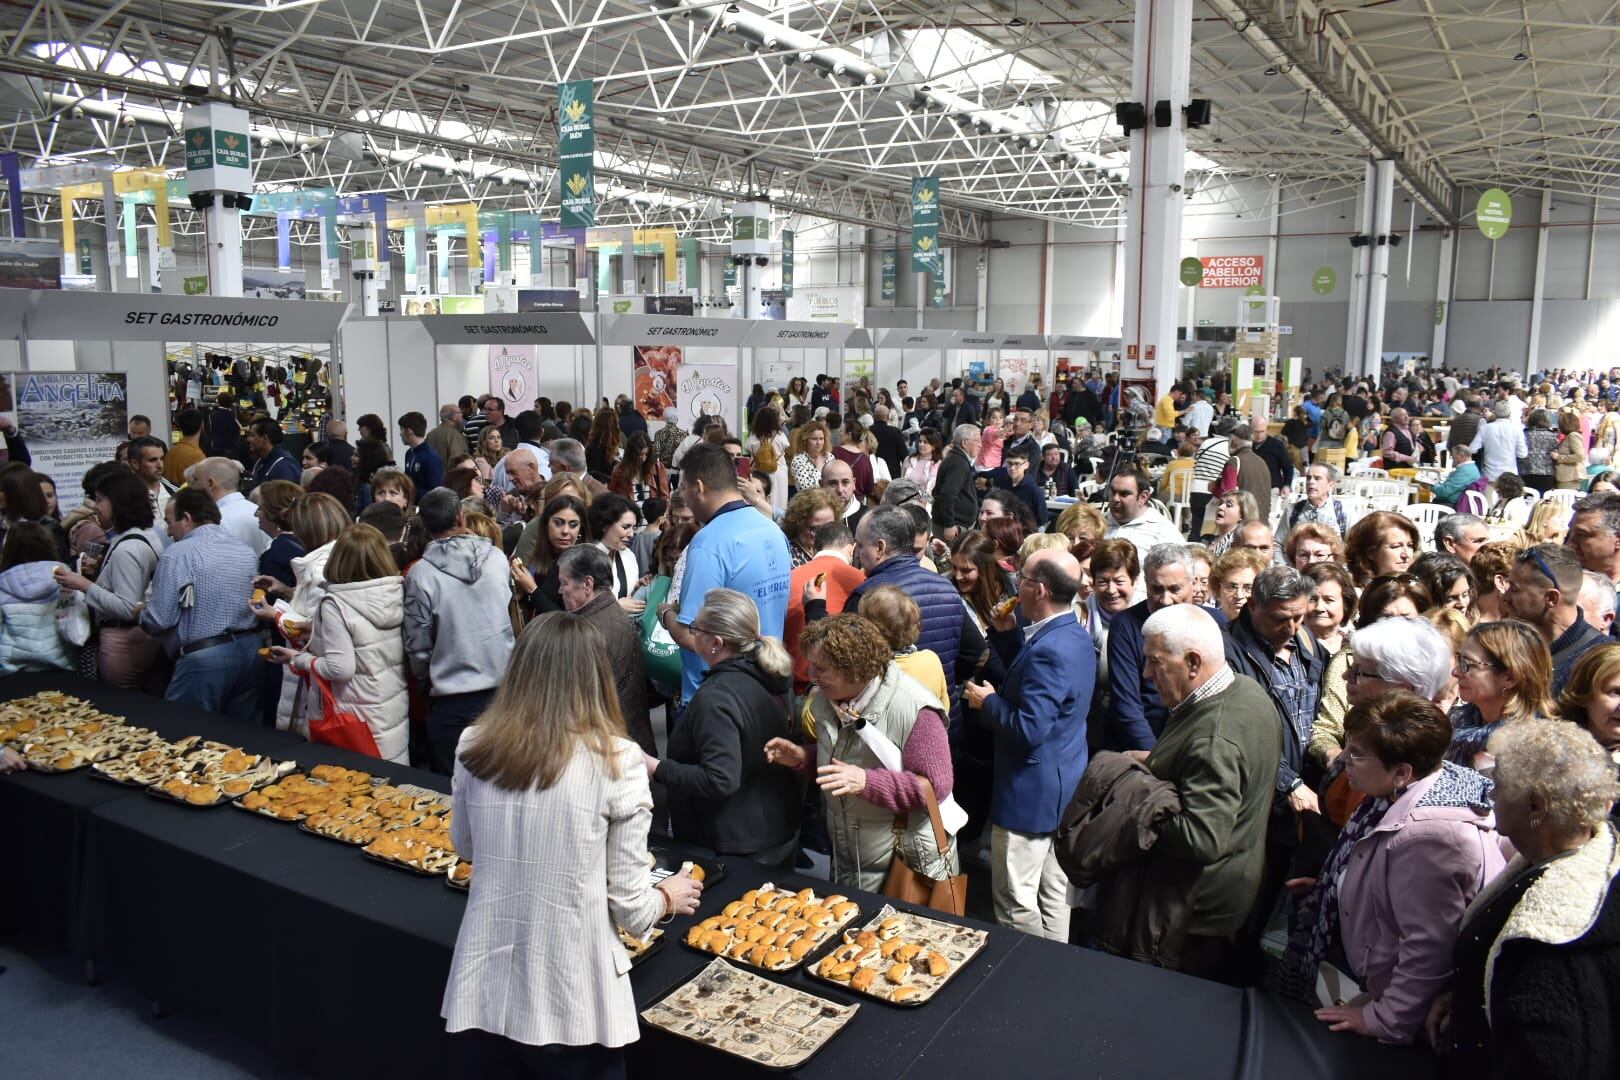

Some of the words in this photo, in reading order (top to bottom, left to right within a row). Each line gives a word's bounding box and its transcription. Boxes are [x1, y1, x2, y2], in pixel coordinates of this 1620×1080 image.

[1208, 257, 1255, 267] ACCESO
[1202, 267, 1260, 277] PABELLON
[1203, 276, 1258, 287] EXTERIOR
[125, 312, 158, 324] SET
[160, 312, 279, 327] GASTRONÓMICO
[464, 325, 481, 334] SET
[482, 325, 548, 335] GASTRONÓMICO
[647, 327, 664, 336] SET
[662, 327, 719, 337] GASTRONÓMICO
[37, 374, 86, 383] EMBUTIDOS
